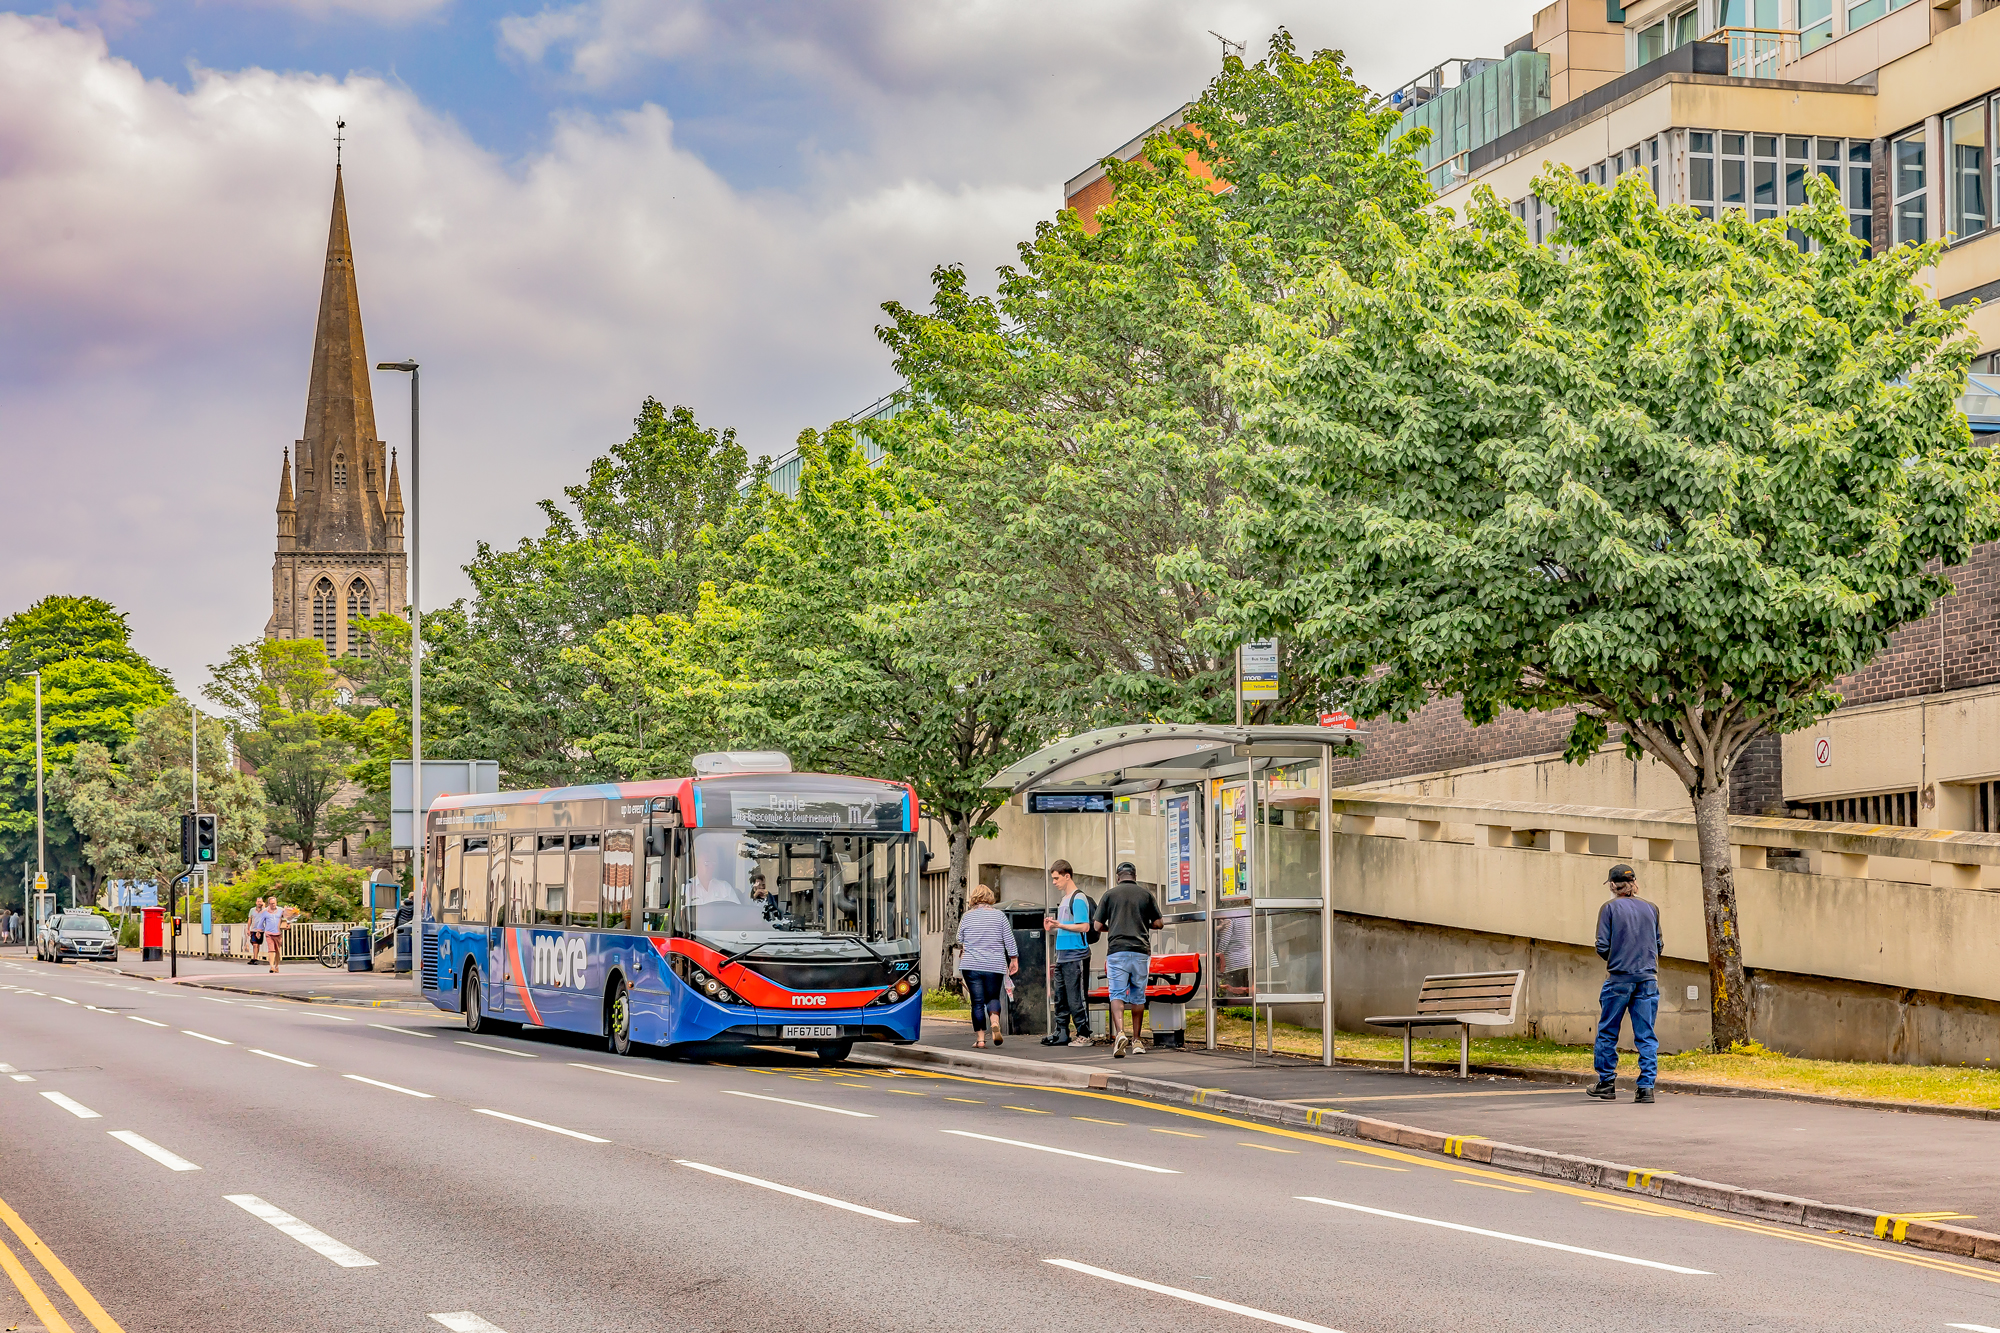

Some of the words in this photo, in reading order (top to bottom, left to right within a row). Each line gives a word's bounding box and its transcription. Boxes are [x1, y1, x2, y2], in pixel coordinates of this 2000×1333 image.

[1323, 716, 1335, 724] Accident
[769, 794, 806, 811] Poole
[631, 804, 645, 817] every
[848, 796, 876, 824] m2
[735, 812, 747, 821] via
[747, 811, 783, 822] Boscombe
[784, 812, 791, 822] &
[792, 812, 841, 823] Bournemouth
[535, 934, 587, 990] more
[895, 962, 909, 971] 222
[791, 995, 827, 1006] more
[787, 1027, 811, 1036] HF67
[814, 1027, 832, 1036] EUC
